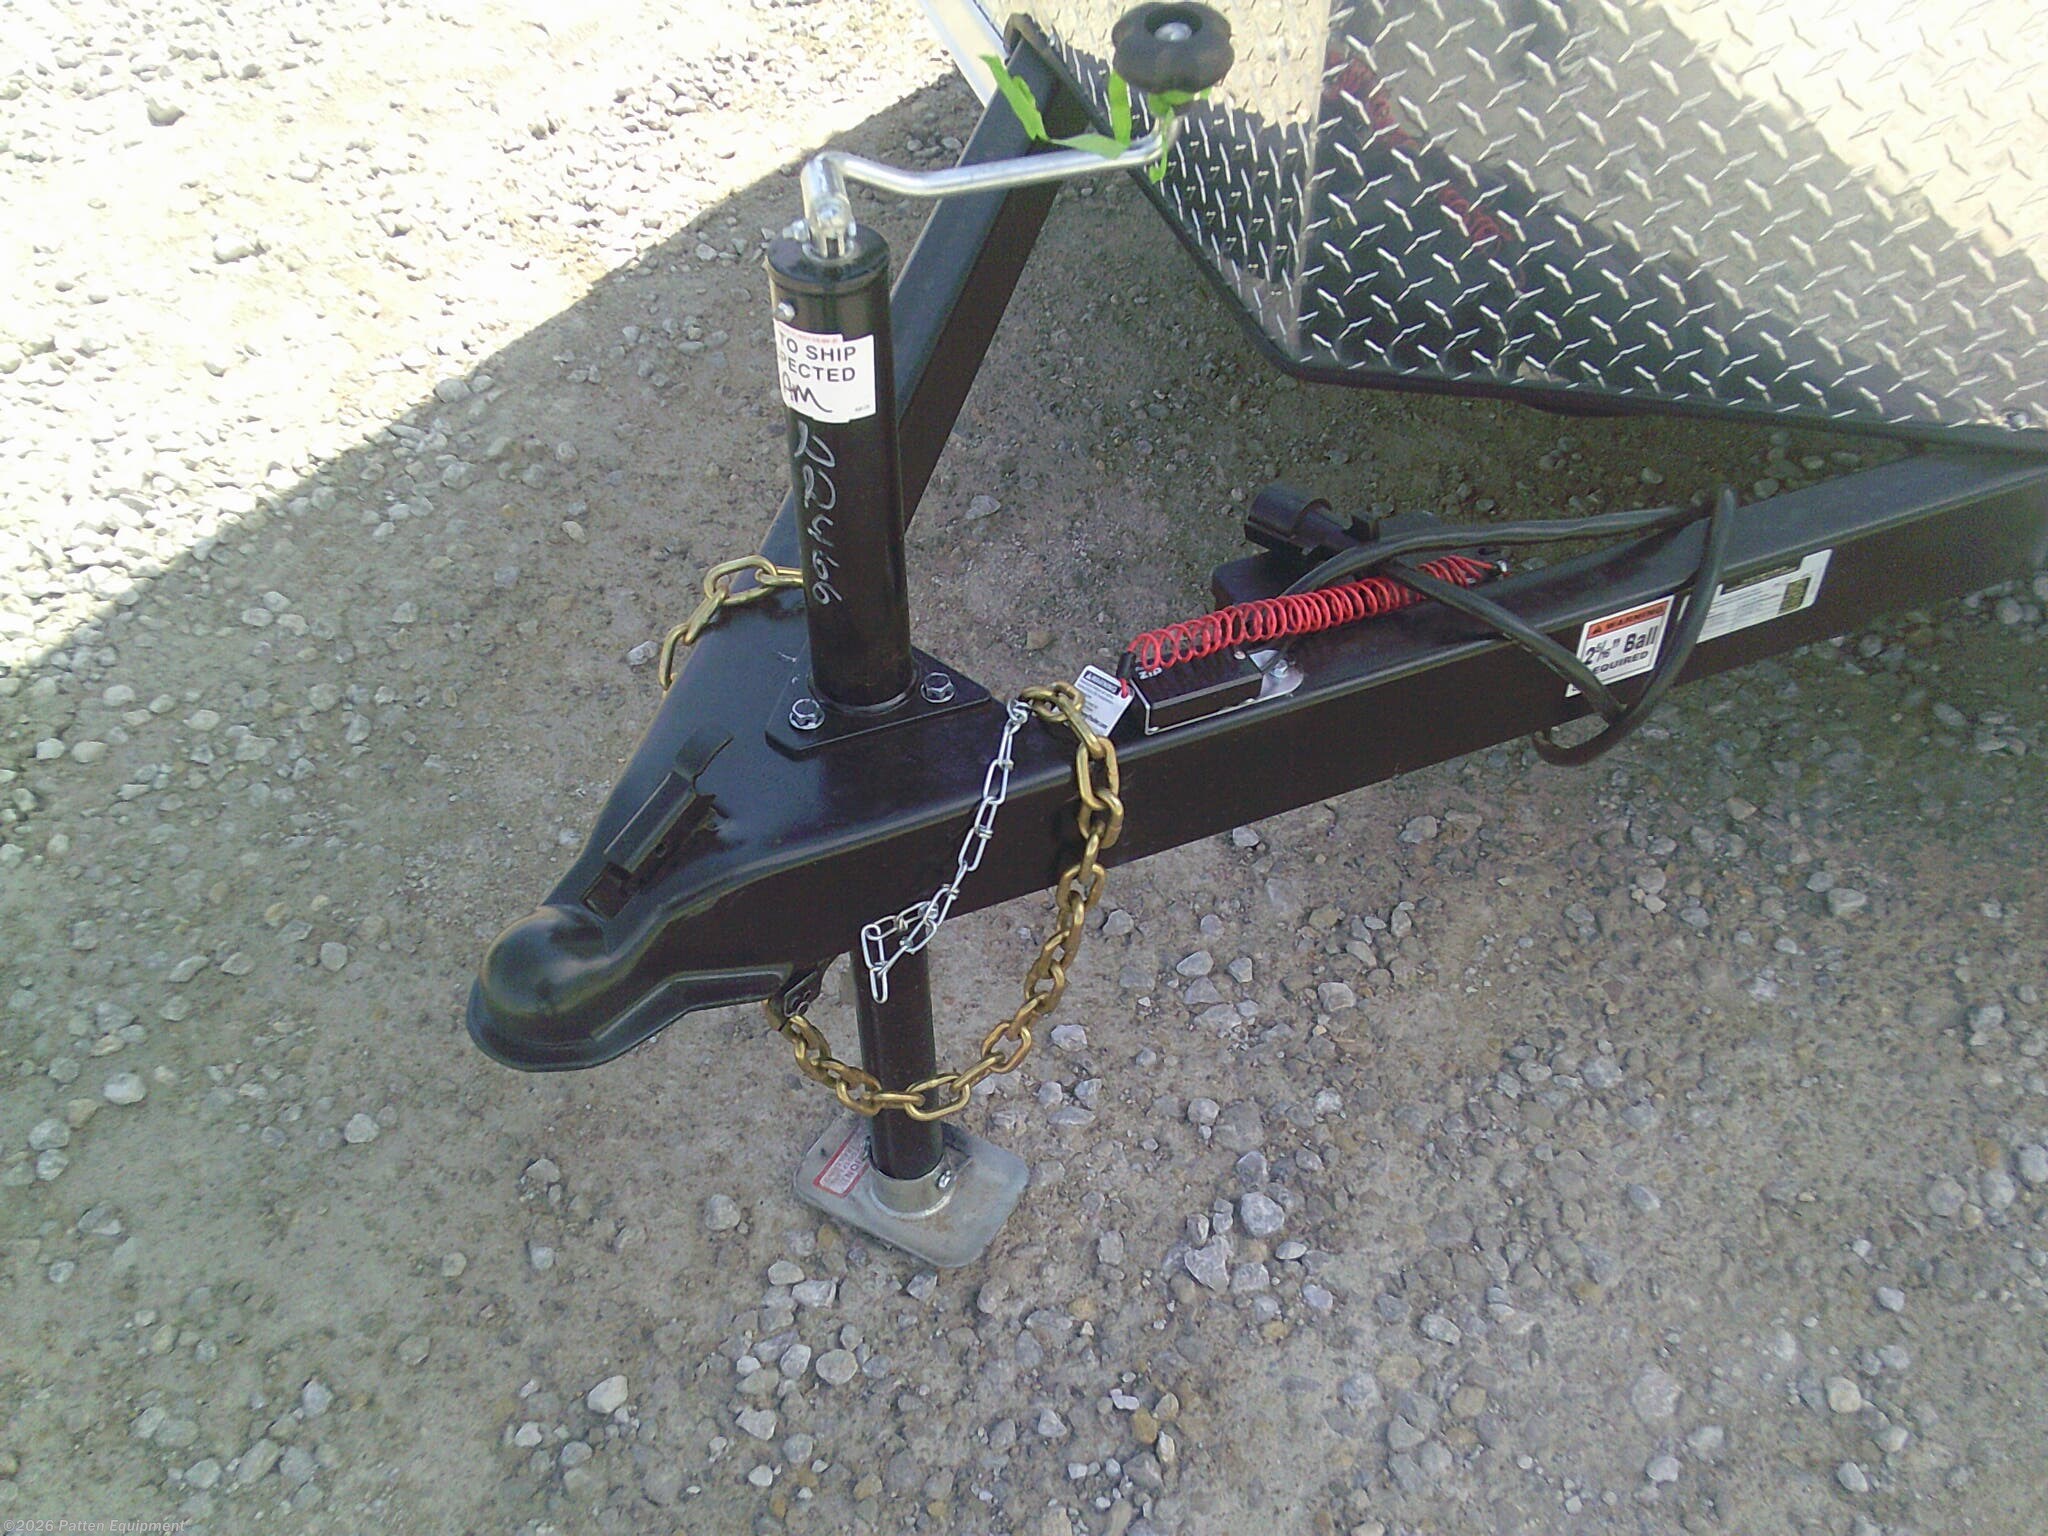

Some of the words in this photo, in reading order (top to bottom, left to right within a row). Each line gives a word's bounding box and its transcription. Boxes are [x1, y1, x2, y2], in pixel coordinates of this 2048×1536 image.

[806, 345, 857, 361] SHIP
[1623, 625, 1659, 654] Ball
[1592, 651, 1649, 674] EQUIRED
